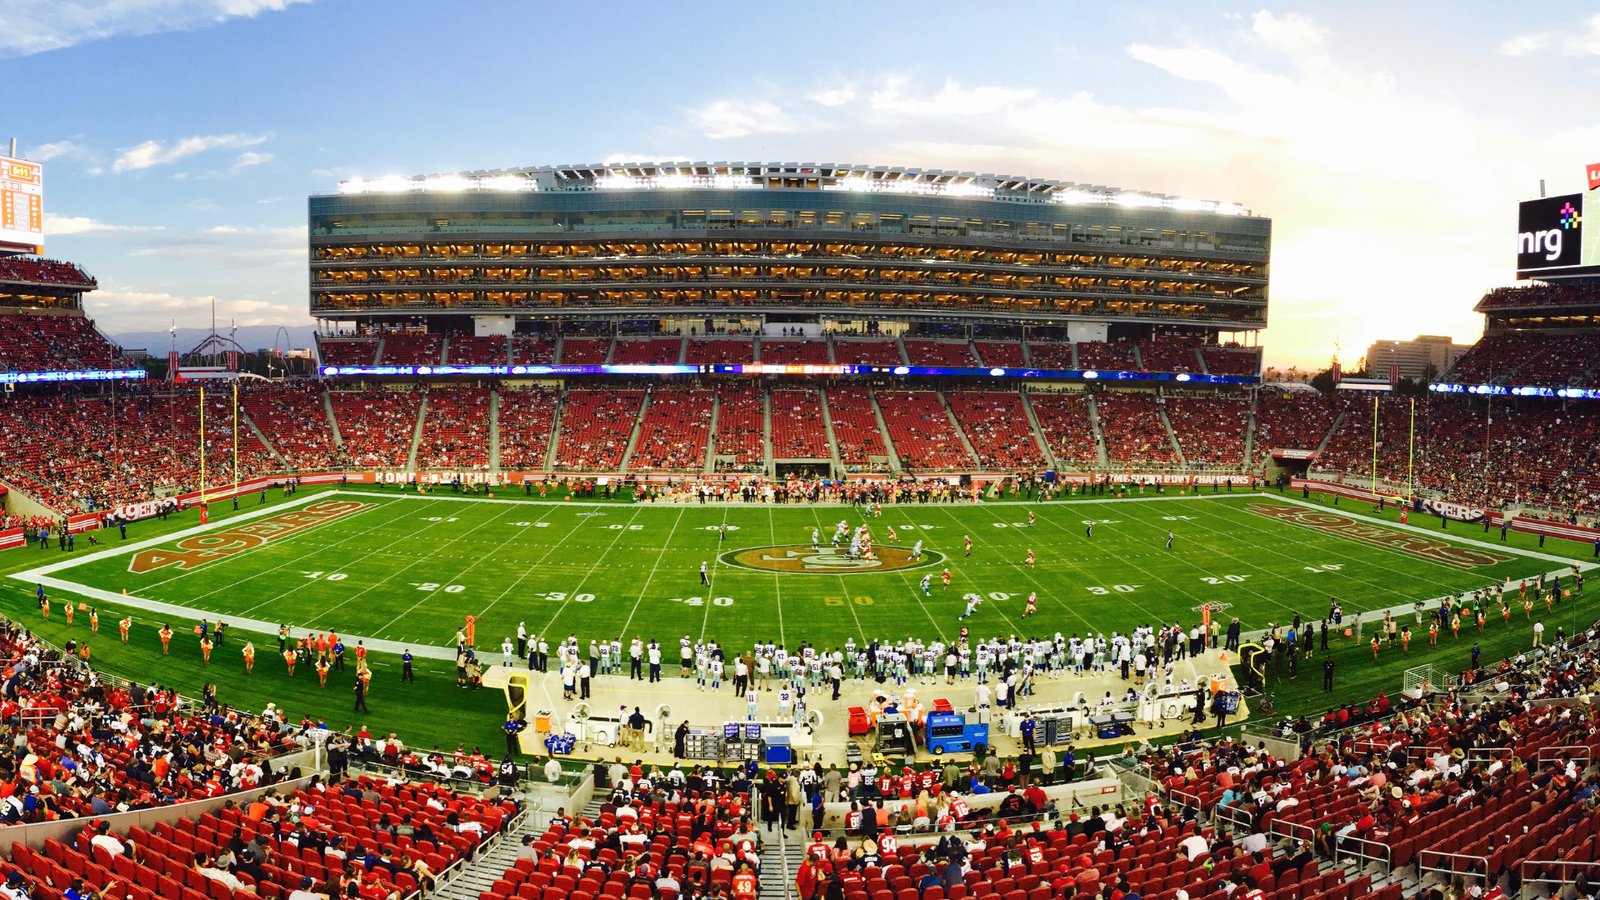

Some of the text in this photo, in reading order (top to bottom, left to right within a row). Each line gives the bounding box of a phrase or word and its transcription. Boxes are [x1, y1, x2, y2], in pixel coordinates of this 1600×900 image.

[1518, 229, 1562, 261] nrg
[127, 500, 380, 574] 49ERS
[1303, 564, 1342, 573] 10
[306, 571, 349, 581] 10
[1200, 574, 1246, 585] 20
[415, 582, 466, 594] 20
[1086, 584, 1136, 595] 30
[545, 591, 596, 603] 30
[684, 596, 735, 607] 40
[824, 596, 874, 606] 50
[961, 628, 968, 636] 3
[812, 663, 819, 671] 51
[748, 694, 754, 702] 11
[780, 693, 789, 701] 32
[501, 764, 513, 775] 54
[673, 777, 679, 787] 9
[935, 773, 940, 781] 7
[207, 788, 213, 797] 7
[955, 803, 970, 818] 16
[881, 838, 897, 853] 94
